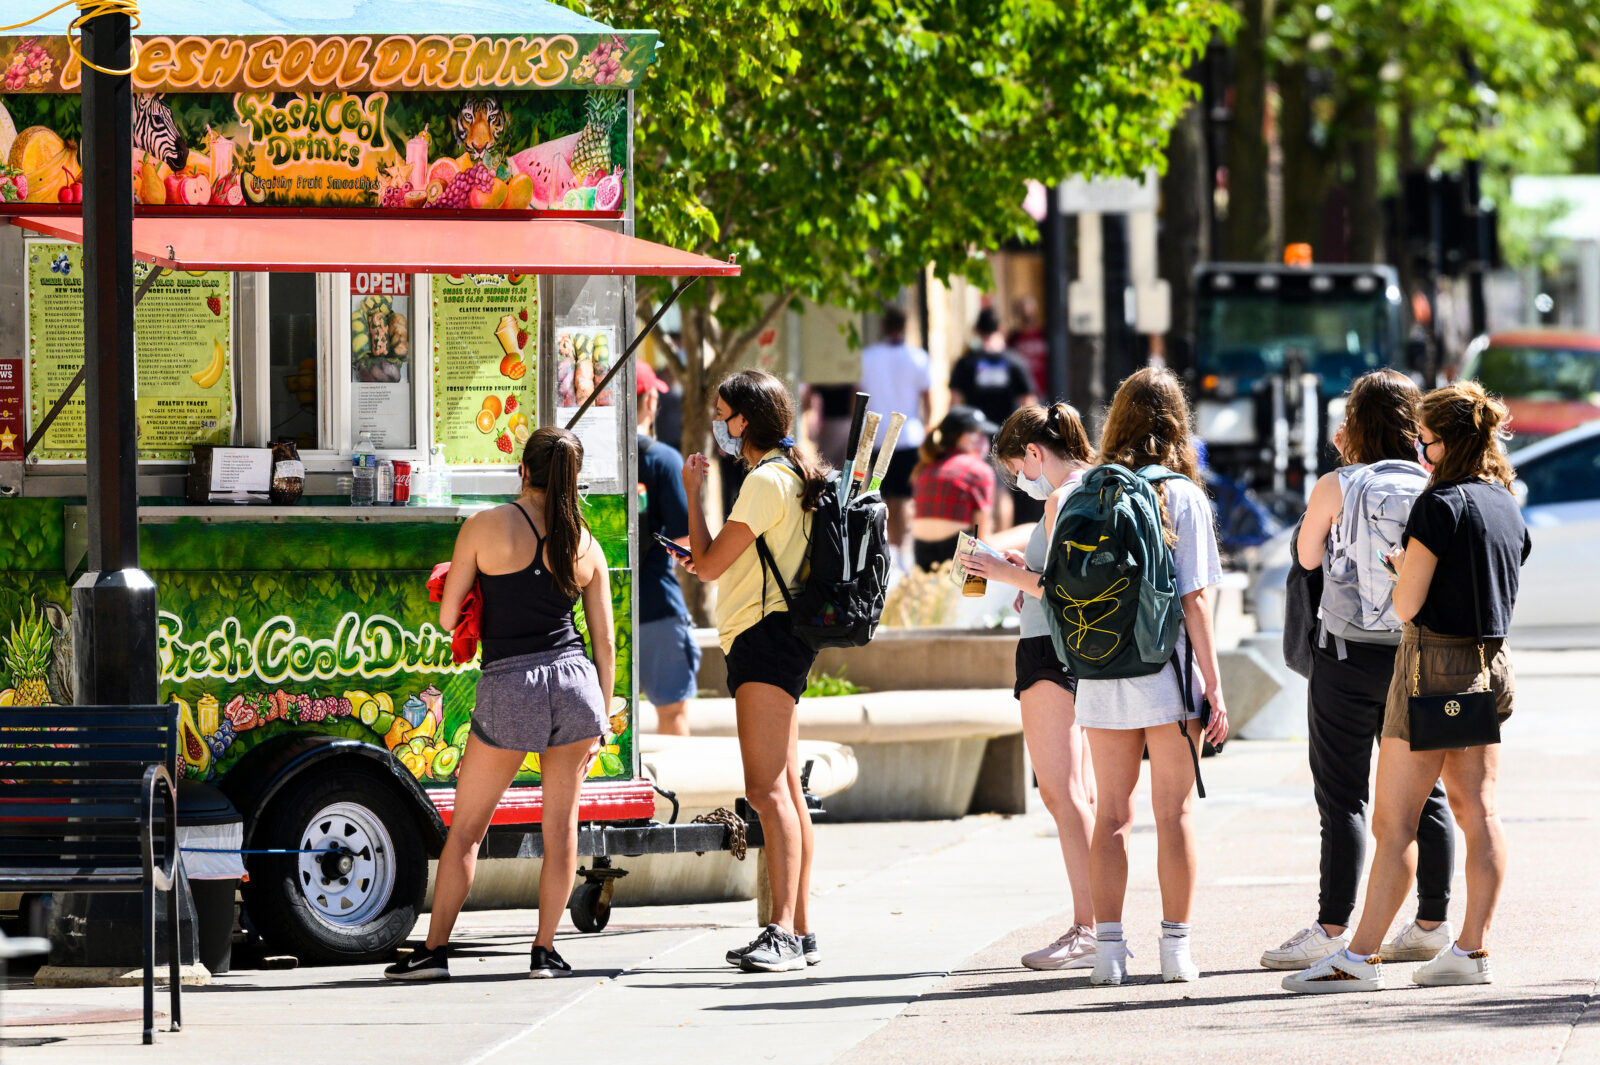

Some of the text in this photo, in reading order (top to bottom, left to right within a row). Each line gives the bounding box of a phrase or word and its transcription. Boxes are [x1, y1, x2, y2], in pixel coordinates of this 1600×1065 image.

[60, 36, 246, 88] eSH
[244, 36, 372, 88] COOL
[234, 92, 387, 149] Fresh Cool
[265, 133, 361, 168] Drinks
[252, 174, 380, 193] Healthy Fruit Smoothies
[356, 272, 405, 294] OPEN
[252, 612, 361, 684] Cool
[360, 613, 483, 678] Drin
